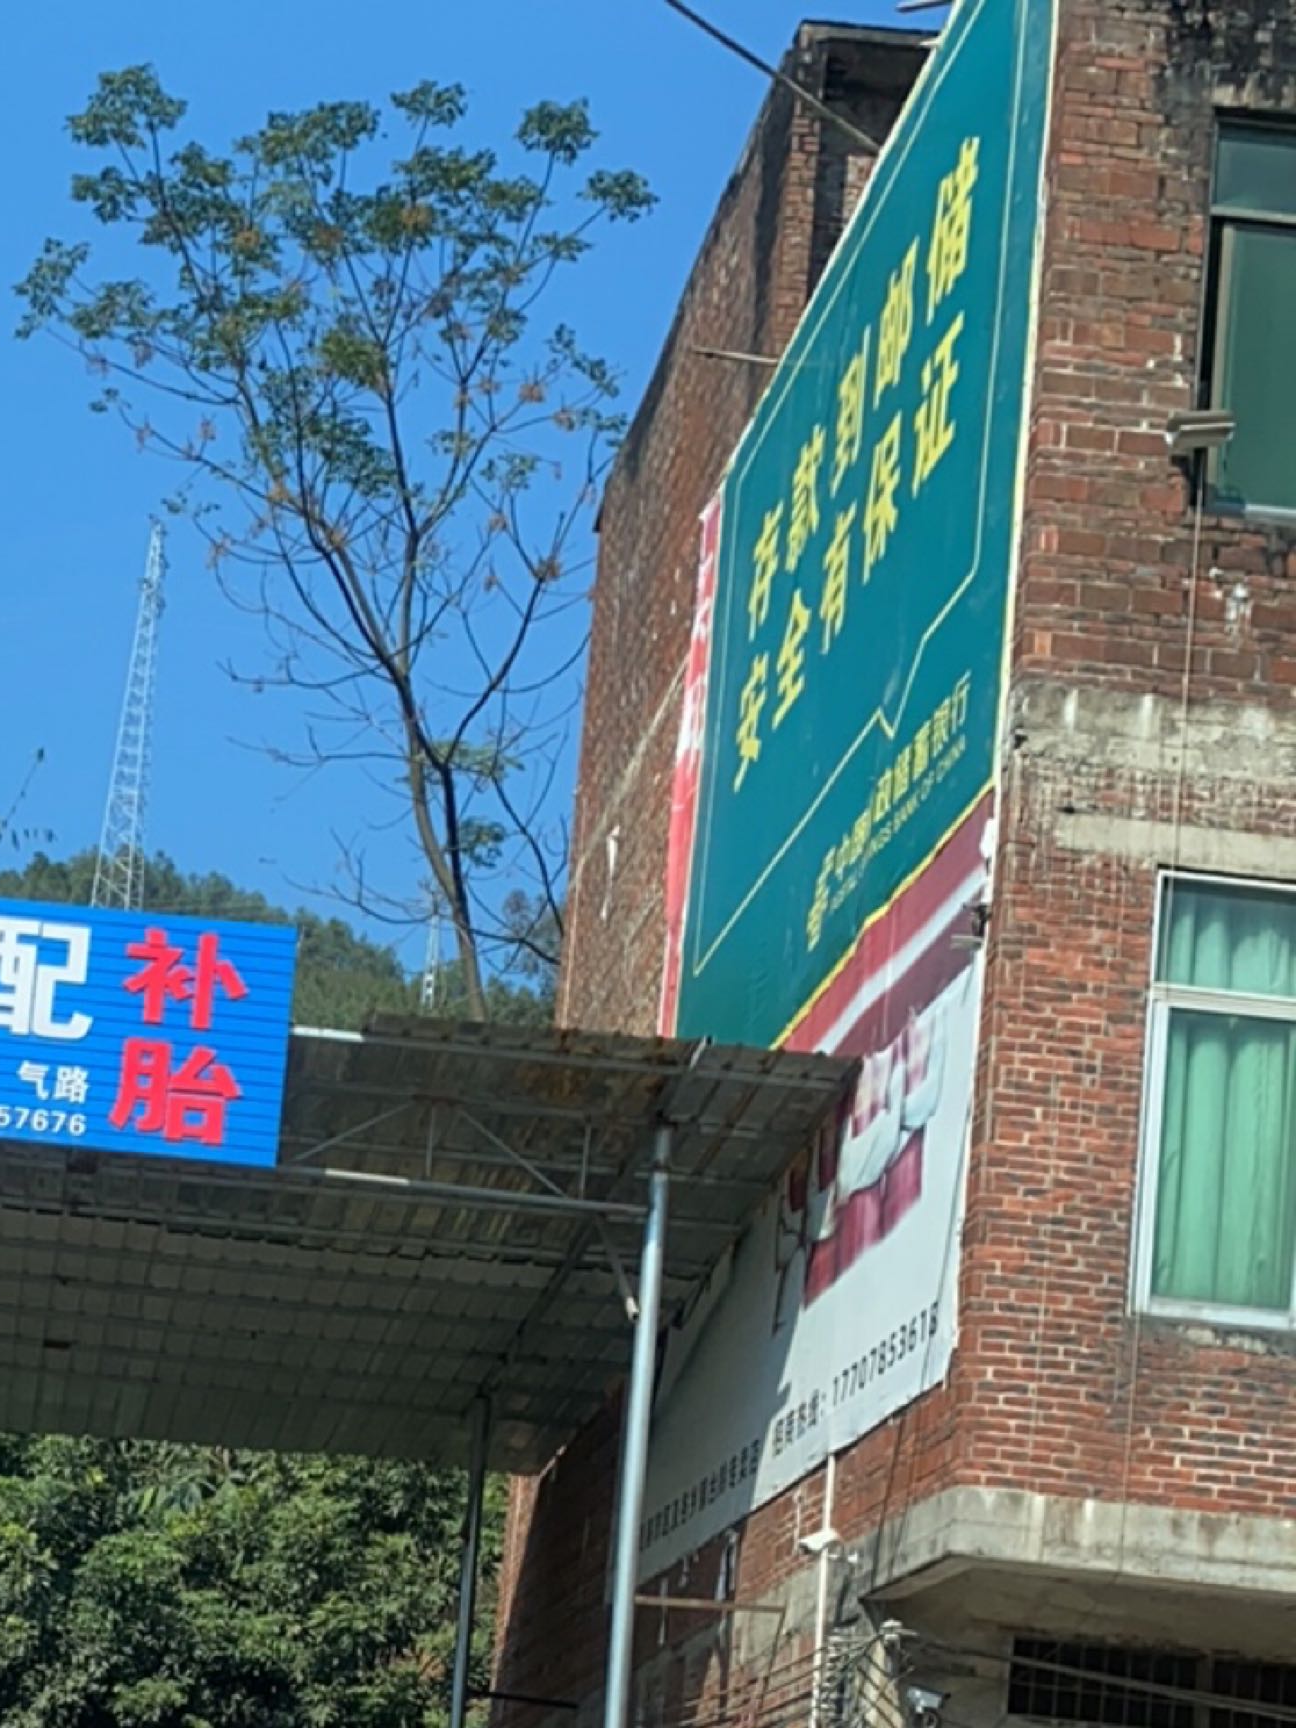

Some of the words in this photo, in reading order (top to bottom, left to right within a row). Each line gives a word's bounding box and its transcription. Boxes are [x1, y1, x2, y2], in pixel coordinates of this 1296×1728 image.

[733, 311, 964, 792] 安全有保证
[748, 135, 980, 641] 存款到邮储
[17, 1061, 90, 1103] 气路
[108, 927, 249, 1146] 补胎
